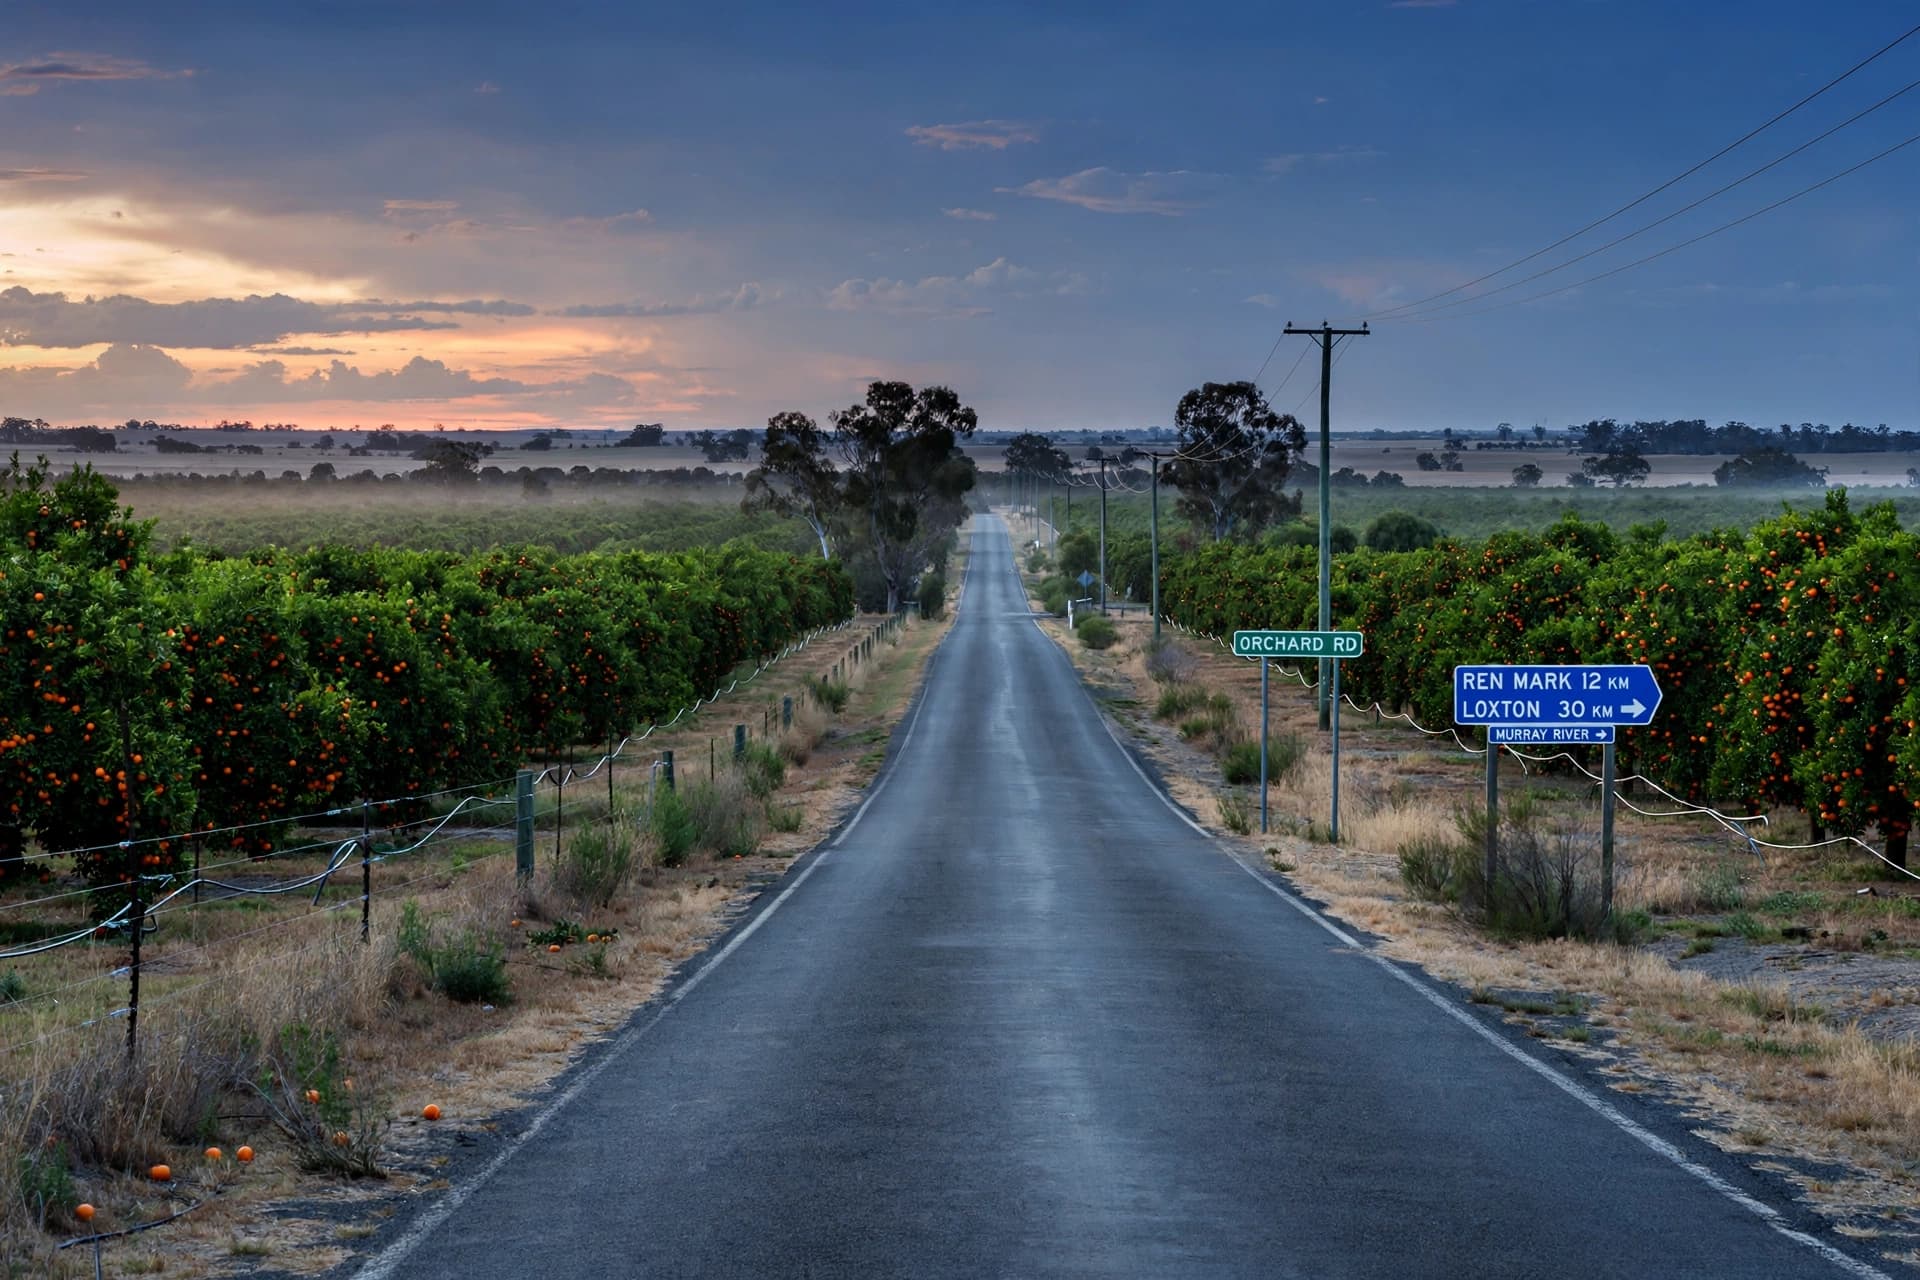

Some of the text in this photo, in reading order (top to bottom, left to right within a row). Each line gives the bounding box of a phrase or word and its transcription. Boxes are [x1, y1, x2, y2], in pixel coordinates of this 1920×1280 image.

[1240, 636, 1357, 652] ORCHARD RD
[1463, 672, 1629, 690] REN MARK 12 KM
[1463, 700, 1613, 718] LOXTON 30 KM
[1496, 728, 1589, 741] MURRAY RIVER
